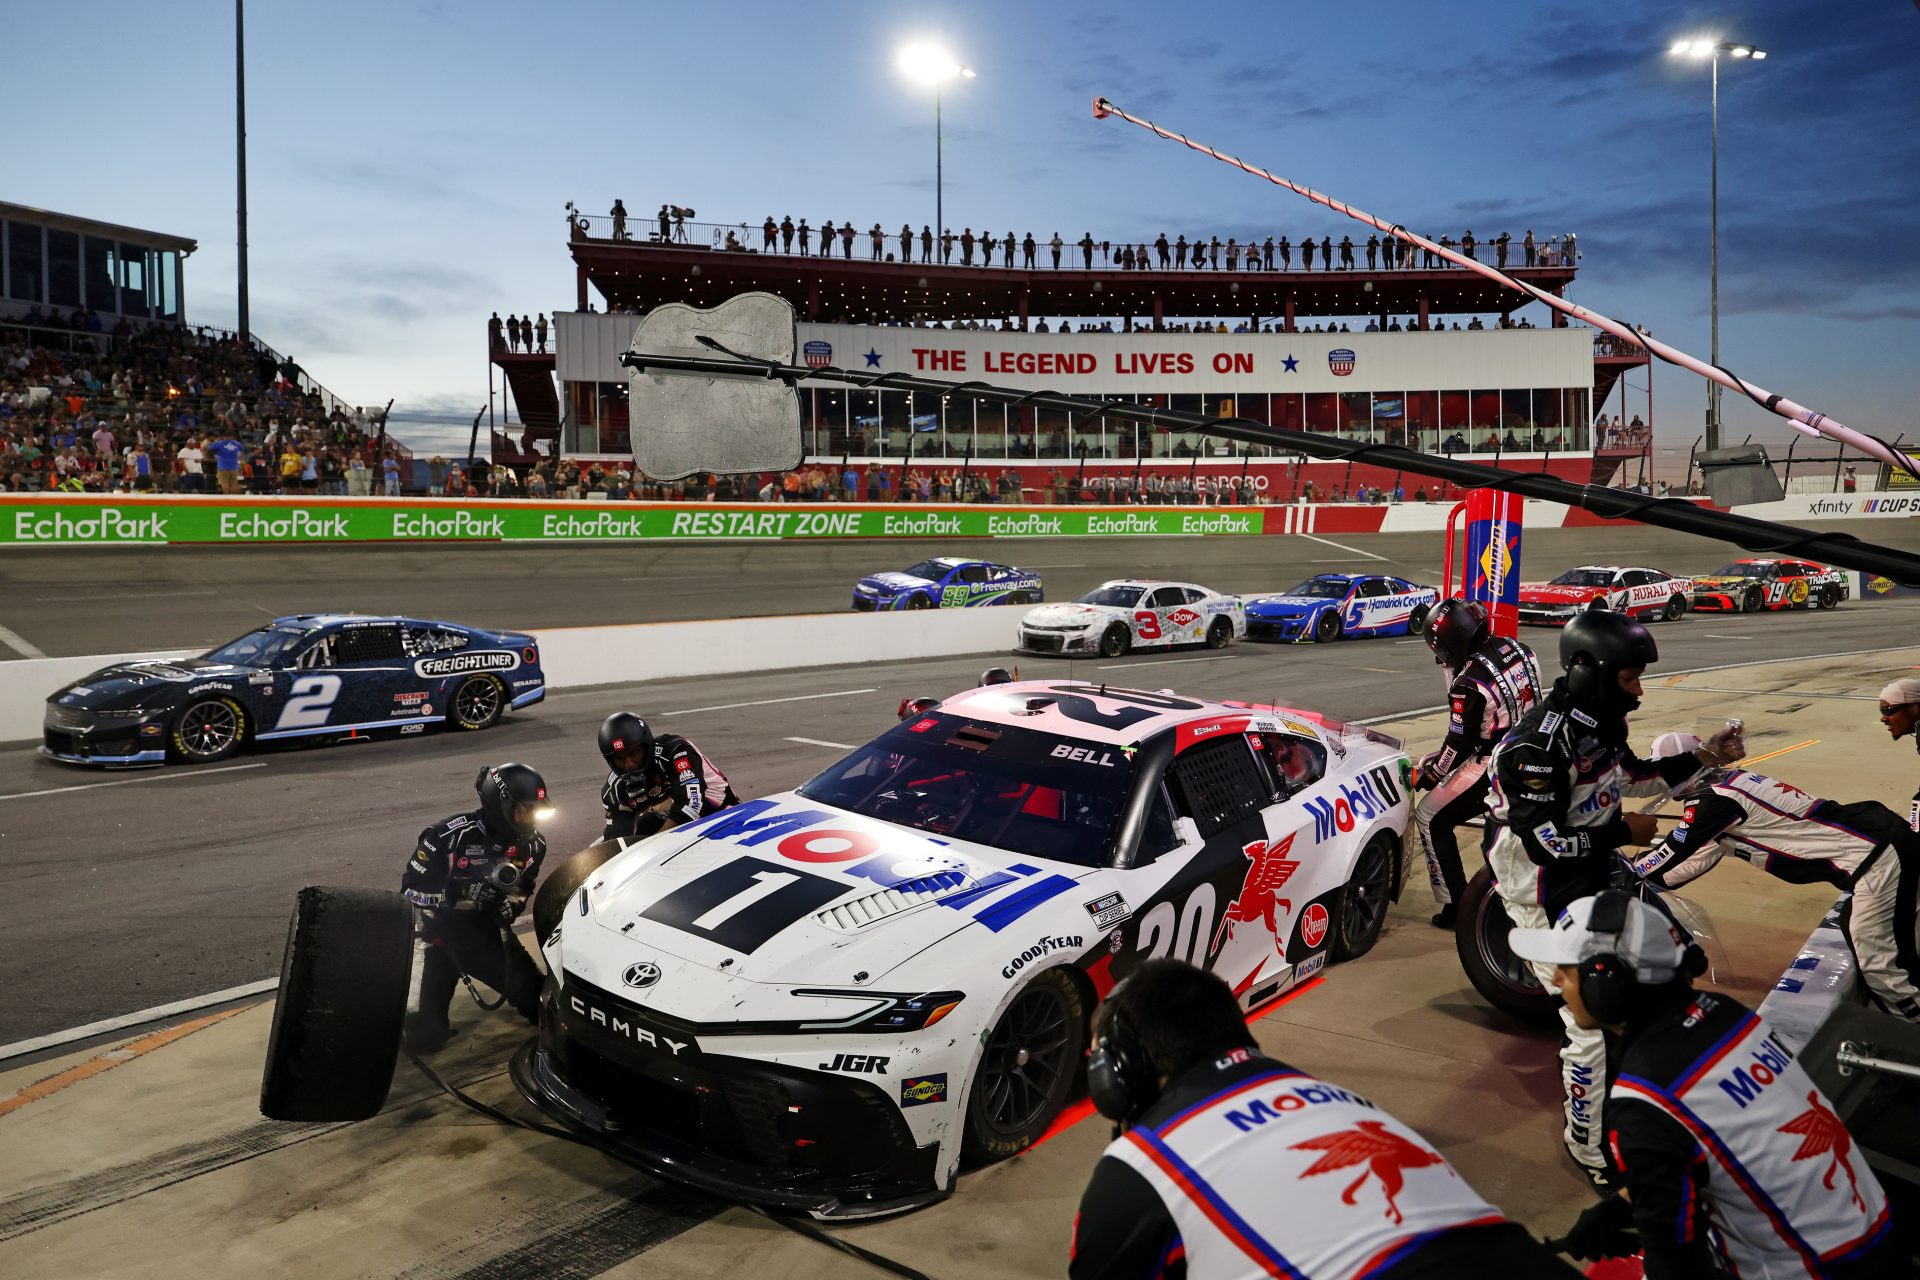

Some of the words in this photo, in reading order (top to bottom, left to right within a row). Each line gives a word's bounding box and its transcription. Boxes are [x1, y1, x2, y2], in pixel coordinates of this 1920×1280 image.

[912, 349, 966, 372] THE
[985, 351, 1097, 374] LEGEND
[1115, 353, 1194, 374] LIVES
[1212, 353, 1254, 374] ON
[1809, 500, 1853, 515] xfinity
[1879, 499, 1908, 512] CUP
[15, 508, 169, 539] EchoPark
[220, 510, 348, 538] EchoPark
[393, 511, 505, 536] EchoPark
[543, 512, 642, 536] EchoPark
[672, 513, 790, 535] RESTART
[795, 513, 861, 535] ZONE
[884, 514, 962, 534] EchoPark
[988, 514, 1062, 534] EchoPark
[1087, 513, 1159, 533] EchoPark
[1182, 513, 1250, 533] EchoPark
[940, 585, 969, 608] 99
[980, 579, 1037, 592] Freeway.com
[1633, 585, 1667, 601] RURAL
[1669, 579, 1689, 595] KING
[1767, 582, 1787, 603] 19
[1868, 581, 1895, 590] SUNOCO
[1613, 590, 1631, 615] 4
[1135, 611, 1161, 639] 3
[1345, 601, 1367, 629] 5
[426, 655, 511, 672] FREIGHTLINER
[275, 675, 342, 730] 2
[1573, 711, 1589, 723] Mobil
[1050, 744, 1116, 767] BELL
[1525, 765, 1553, 773] NASCAR
[1303, 773, 1387, 845] Mobil
[1371, 765, 1401, 807] 1
[670, 799, 1080, 933] Mobil
[1636, 854, 1661, 875] Mobil
[406, 891, 430, 904] Mobil
[1099, 895, 1119, 909] NASCAR
[1099, 912, 1108, 922] CUP
[1108, 906, 1125, 919] SERIES
[1136, 882, 1216, 968] 20
[1304, 907, 1327, 941] Rheem
[1002, 935, 1083, 979] GOODYEAR
[1298, 959, 1316, 978] Mobil
[571, 996, 688, 1055] CAMRY
[819, 1054, 890, 1074] JGR
[1718, 1040, 1790, 1108] Mobil
[904, 1084, 944, 1097] SUNOCO
[1571, 1062, 1592, 1123] Mobil
